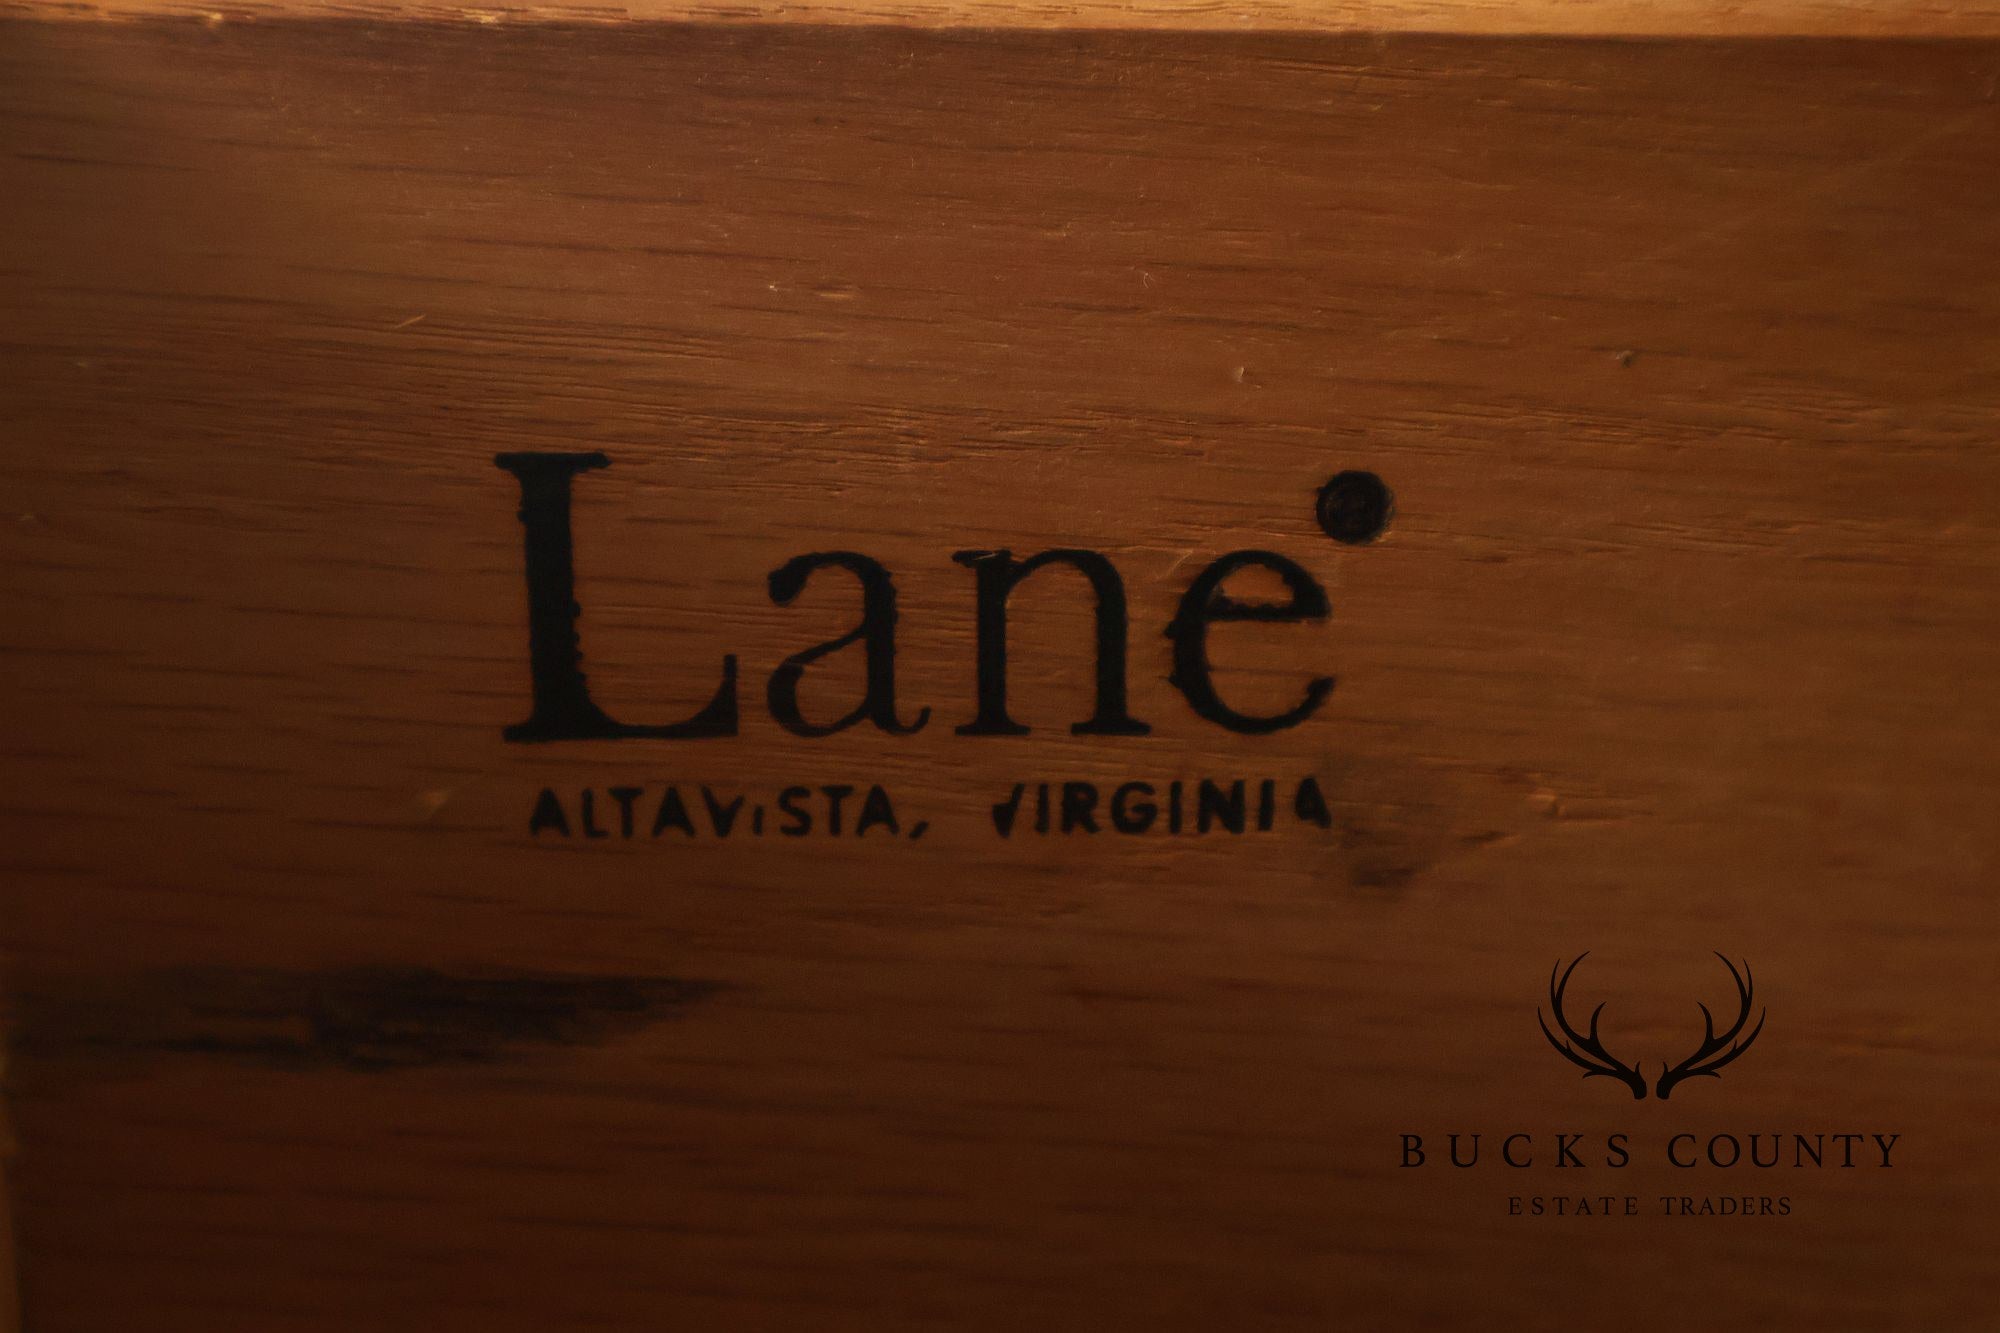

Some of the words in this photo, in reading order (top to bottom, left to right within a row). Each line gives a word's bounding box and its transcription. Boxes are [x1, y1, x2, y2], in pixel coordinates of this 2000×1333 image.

[494, 452, 1335, 741] Lane
[529, 784, 930, 839] ALTAVISTA,
[991, 776, 1332, 839] VIRGINIA
